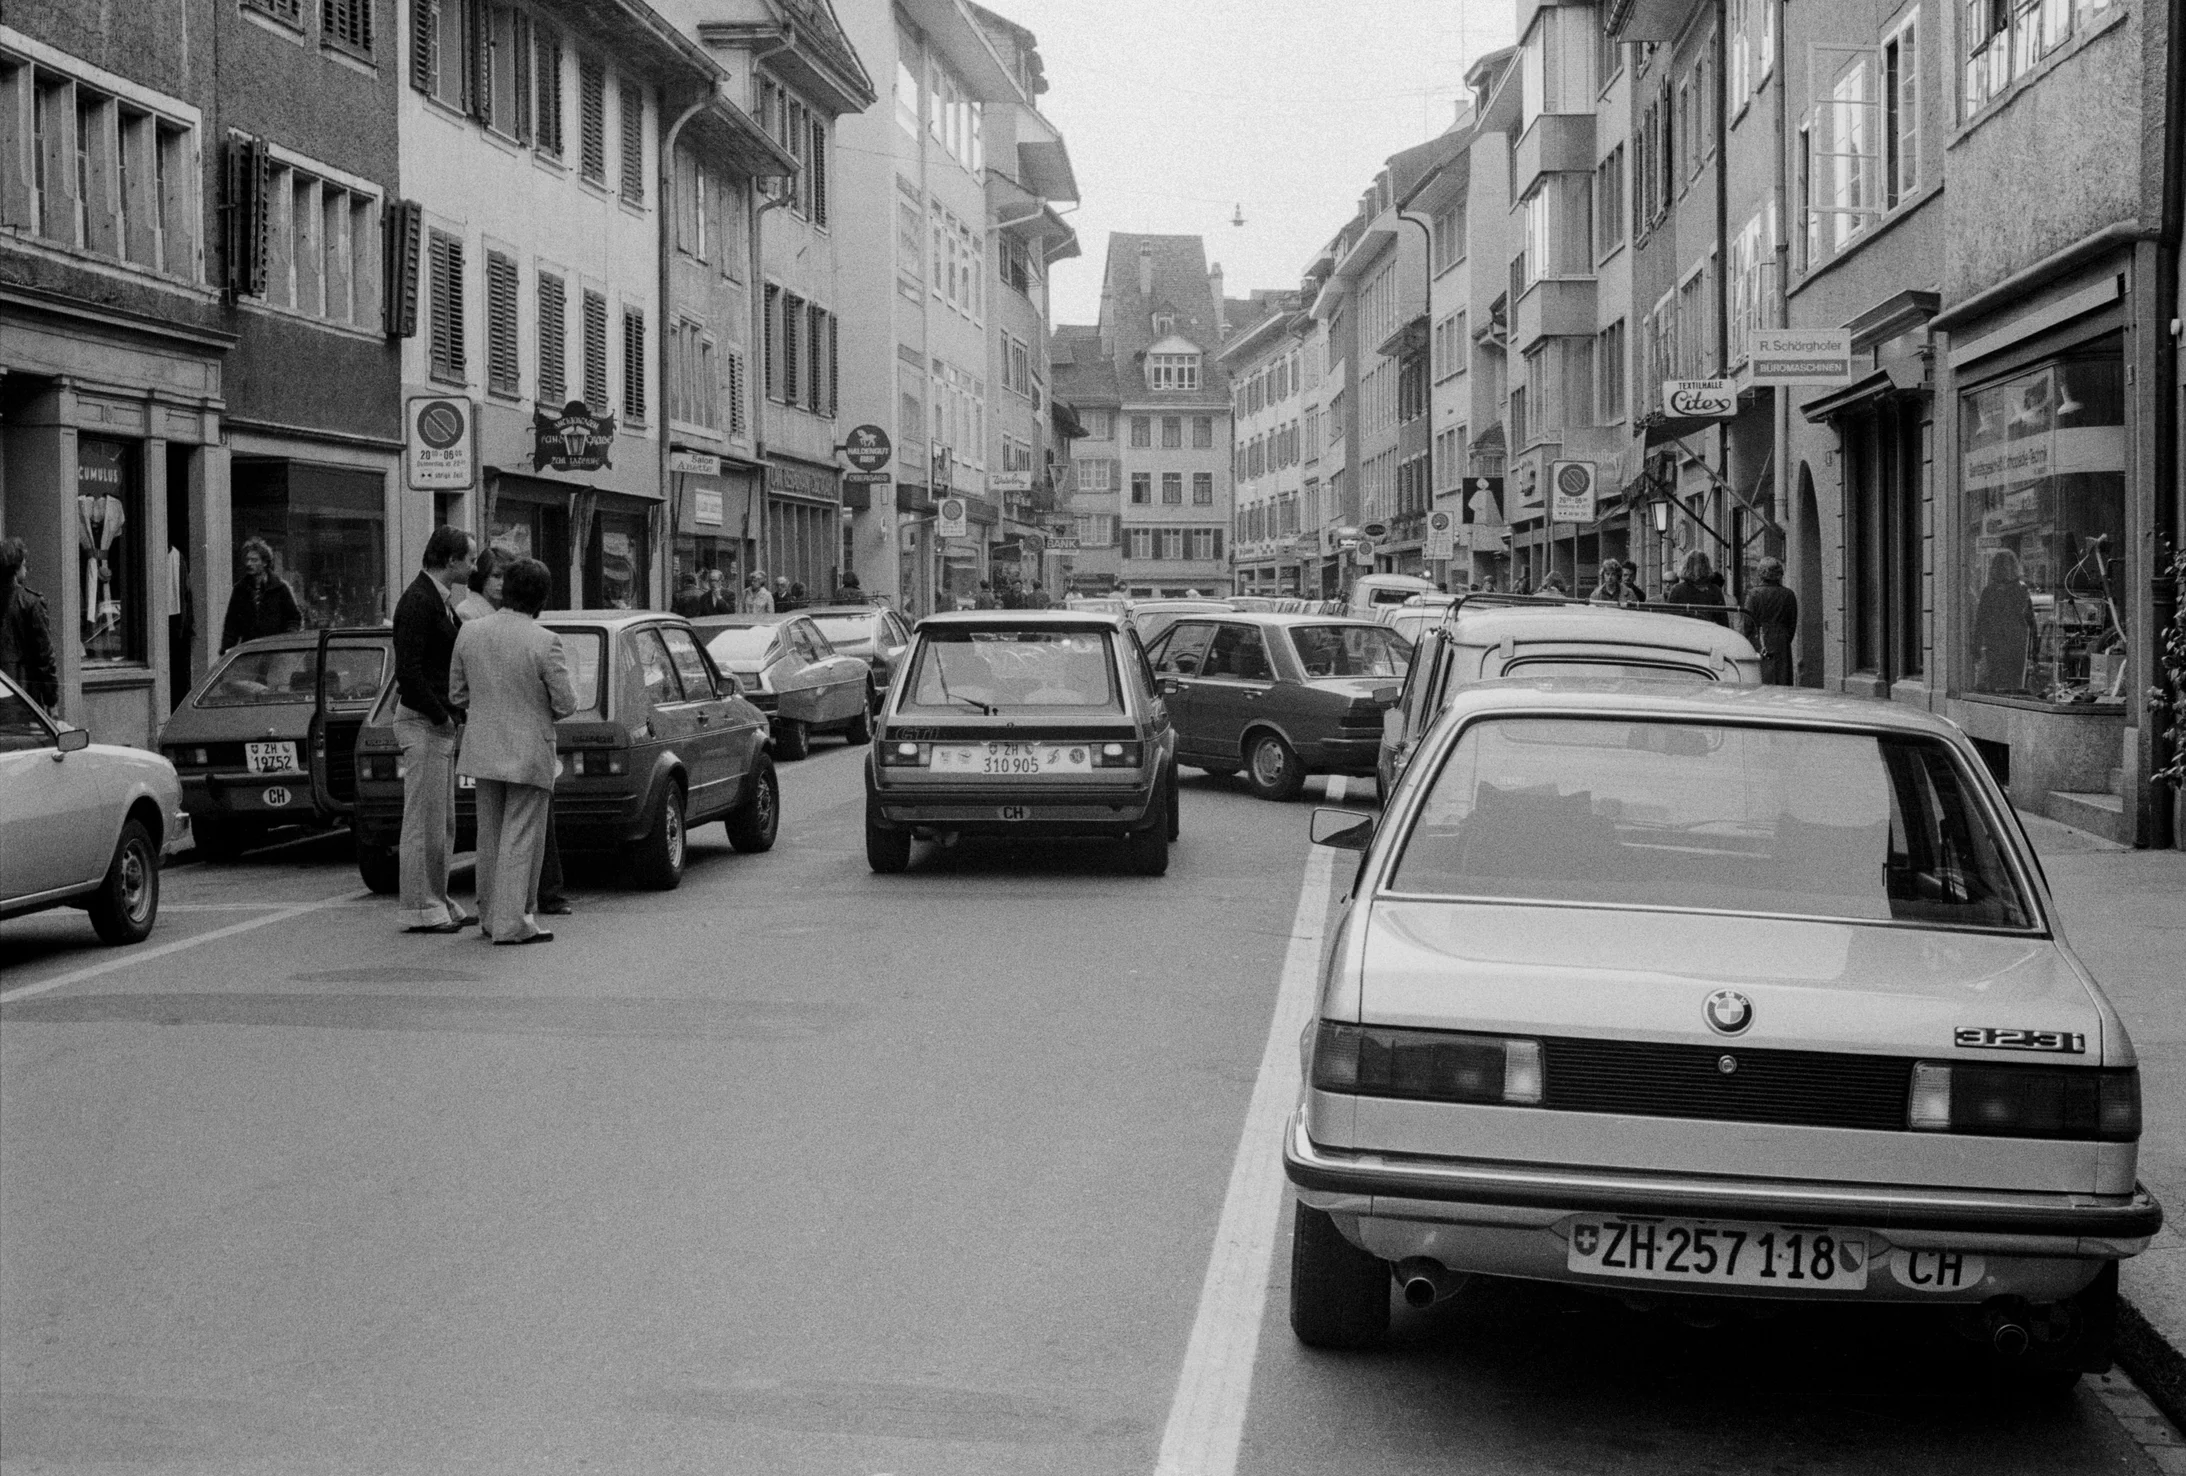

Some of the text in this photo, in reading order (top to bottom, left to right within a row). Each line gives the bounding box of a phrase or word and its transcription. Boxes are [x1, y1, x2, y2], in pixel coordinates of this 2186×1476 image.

[1773, 340, 1843, 353] Schörghofer
[1760, 361, 1842, 373] BÜROMASCHINEN
[1678, 381, 1723, 390] TEXTILHALLE
[1671, 390, 1731, 416] Citex
[847, 447, 889, 455] HALDENGUT
[692, 454, 714, 465] Salon
[79, 466, 118, 483] CUMULUS
[1046, 540, 1077, 548] BANK
[264, 744, 278, 754] ZH
[1004, 744, 1019, 756] ZH
[254, 756, 292, 770] 19752
[984, 757, 1039, 773] 310 905
[268, 789, 285, 804] CH
[1003, 806, 1024, 819] CH
[1908, 1252, 1964, 1286] CH
